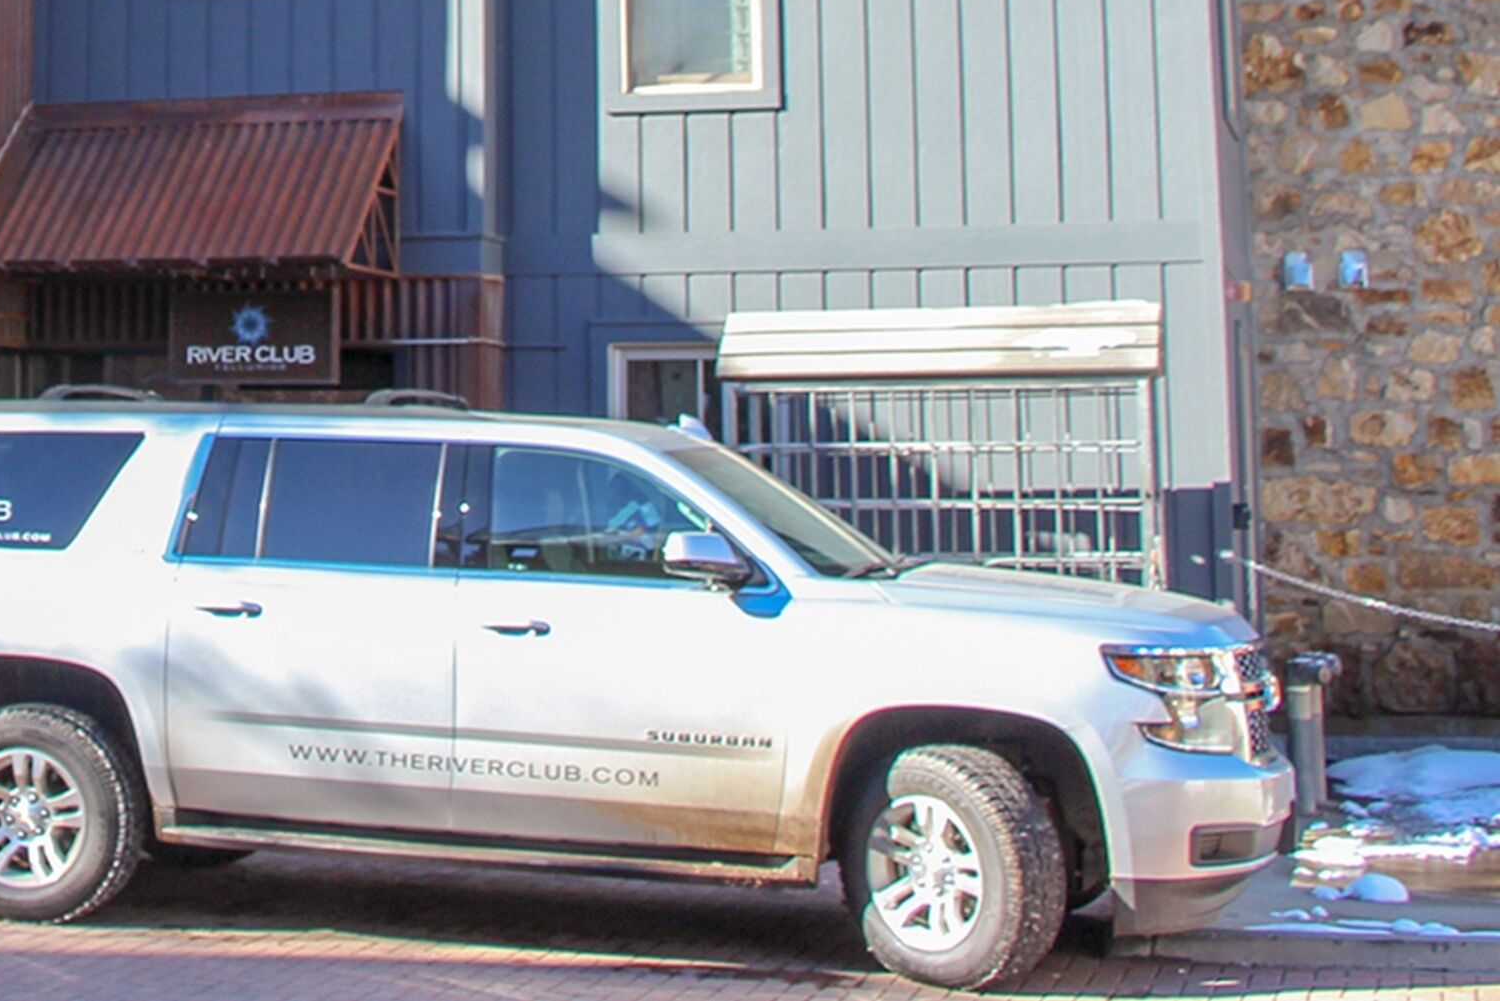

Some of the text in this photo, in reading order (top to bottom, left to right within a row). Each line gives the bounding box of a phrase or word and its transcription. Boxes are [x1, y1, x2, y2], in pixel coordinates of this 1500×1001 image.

[186, 344, 316, 365] RIVER CLUB
[647, 730, 772, 748] SUBURBAN
[289, 744, 659, 787] WWW.THERIVERCLUB.COM
